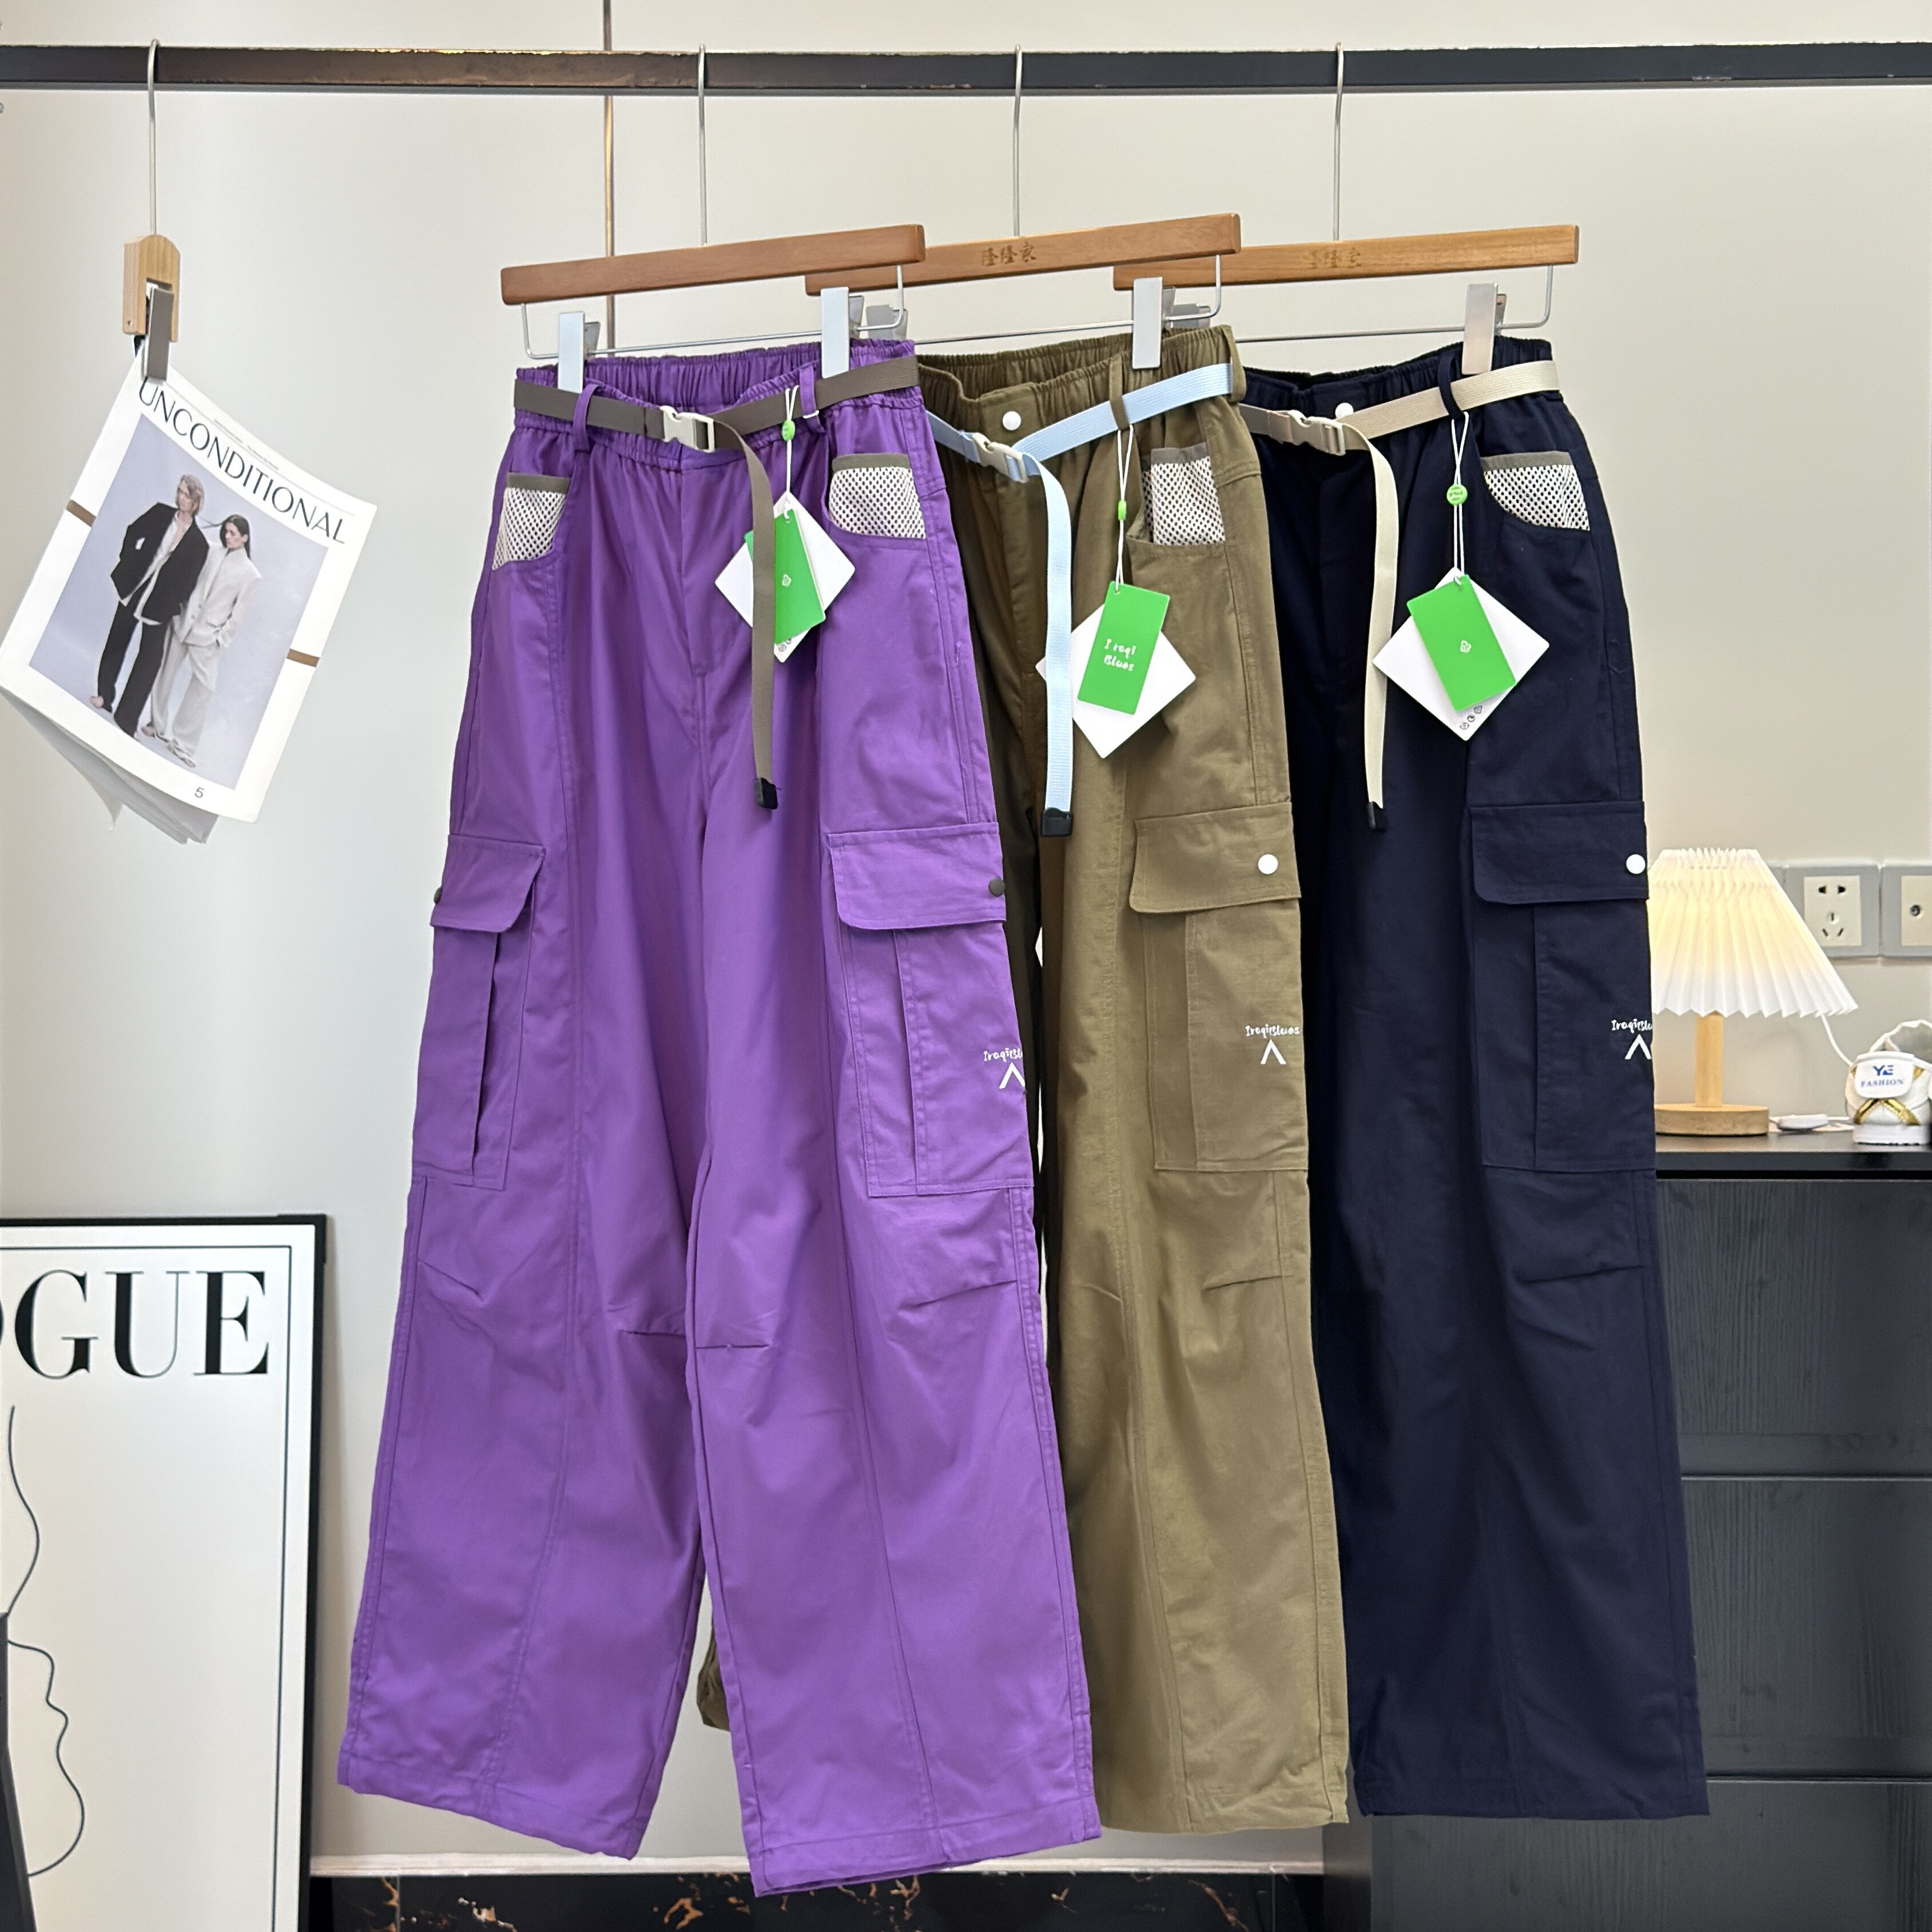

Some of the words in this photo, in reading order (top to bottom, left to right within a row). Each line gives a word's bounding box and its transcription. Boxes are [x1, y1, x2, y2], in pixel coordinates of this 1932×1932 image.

[138, 376, 345, 544] UNCONDITIONAL
[194, 787, 205, 798] 5
[1861, 1079, 1904, 1087] FASHION
[0, 1269, 269, 1380] GUE
